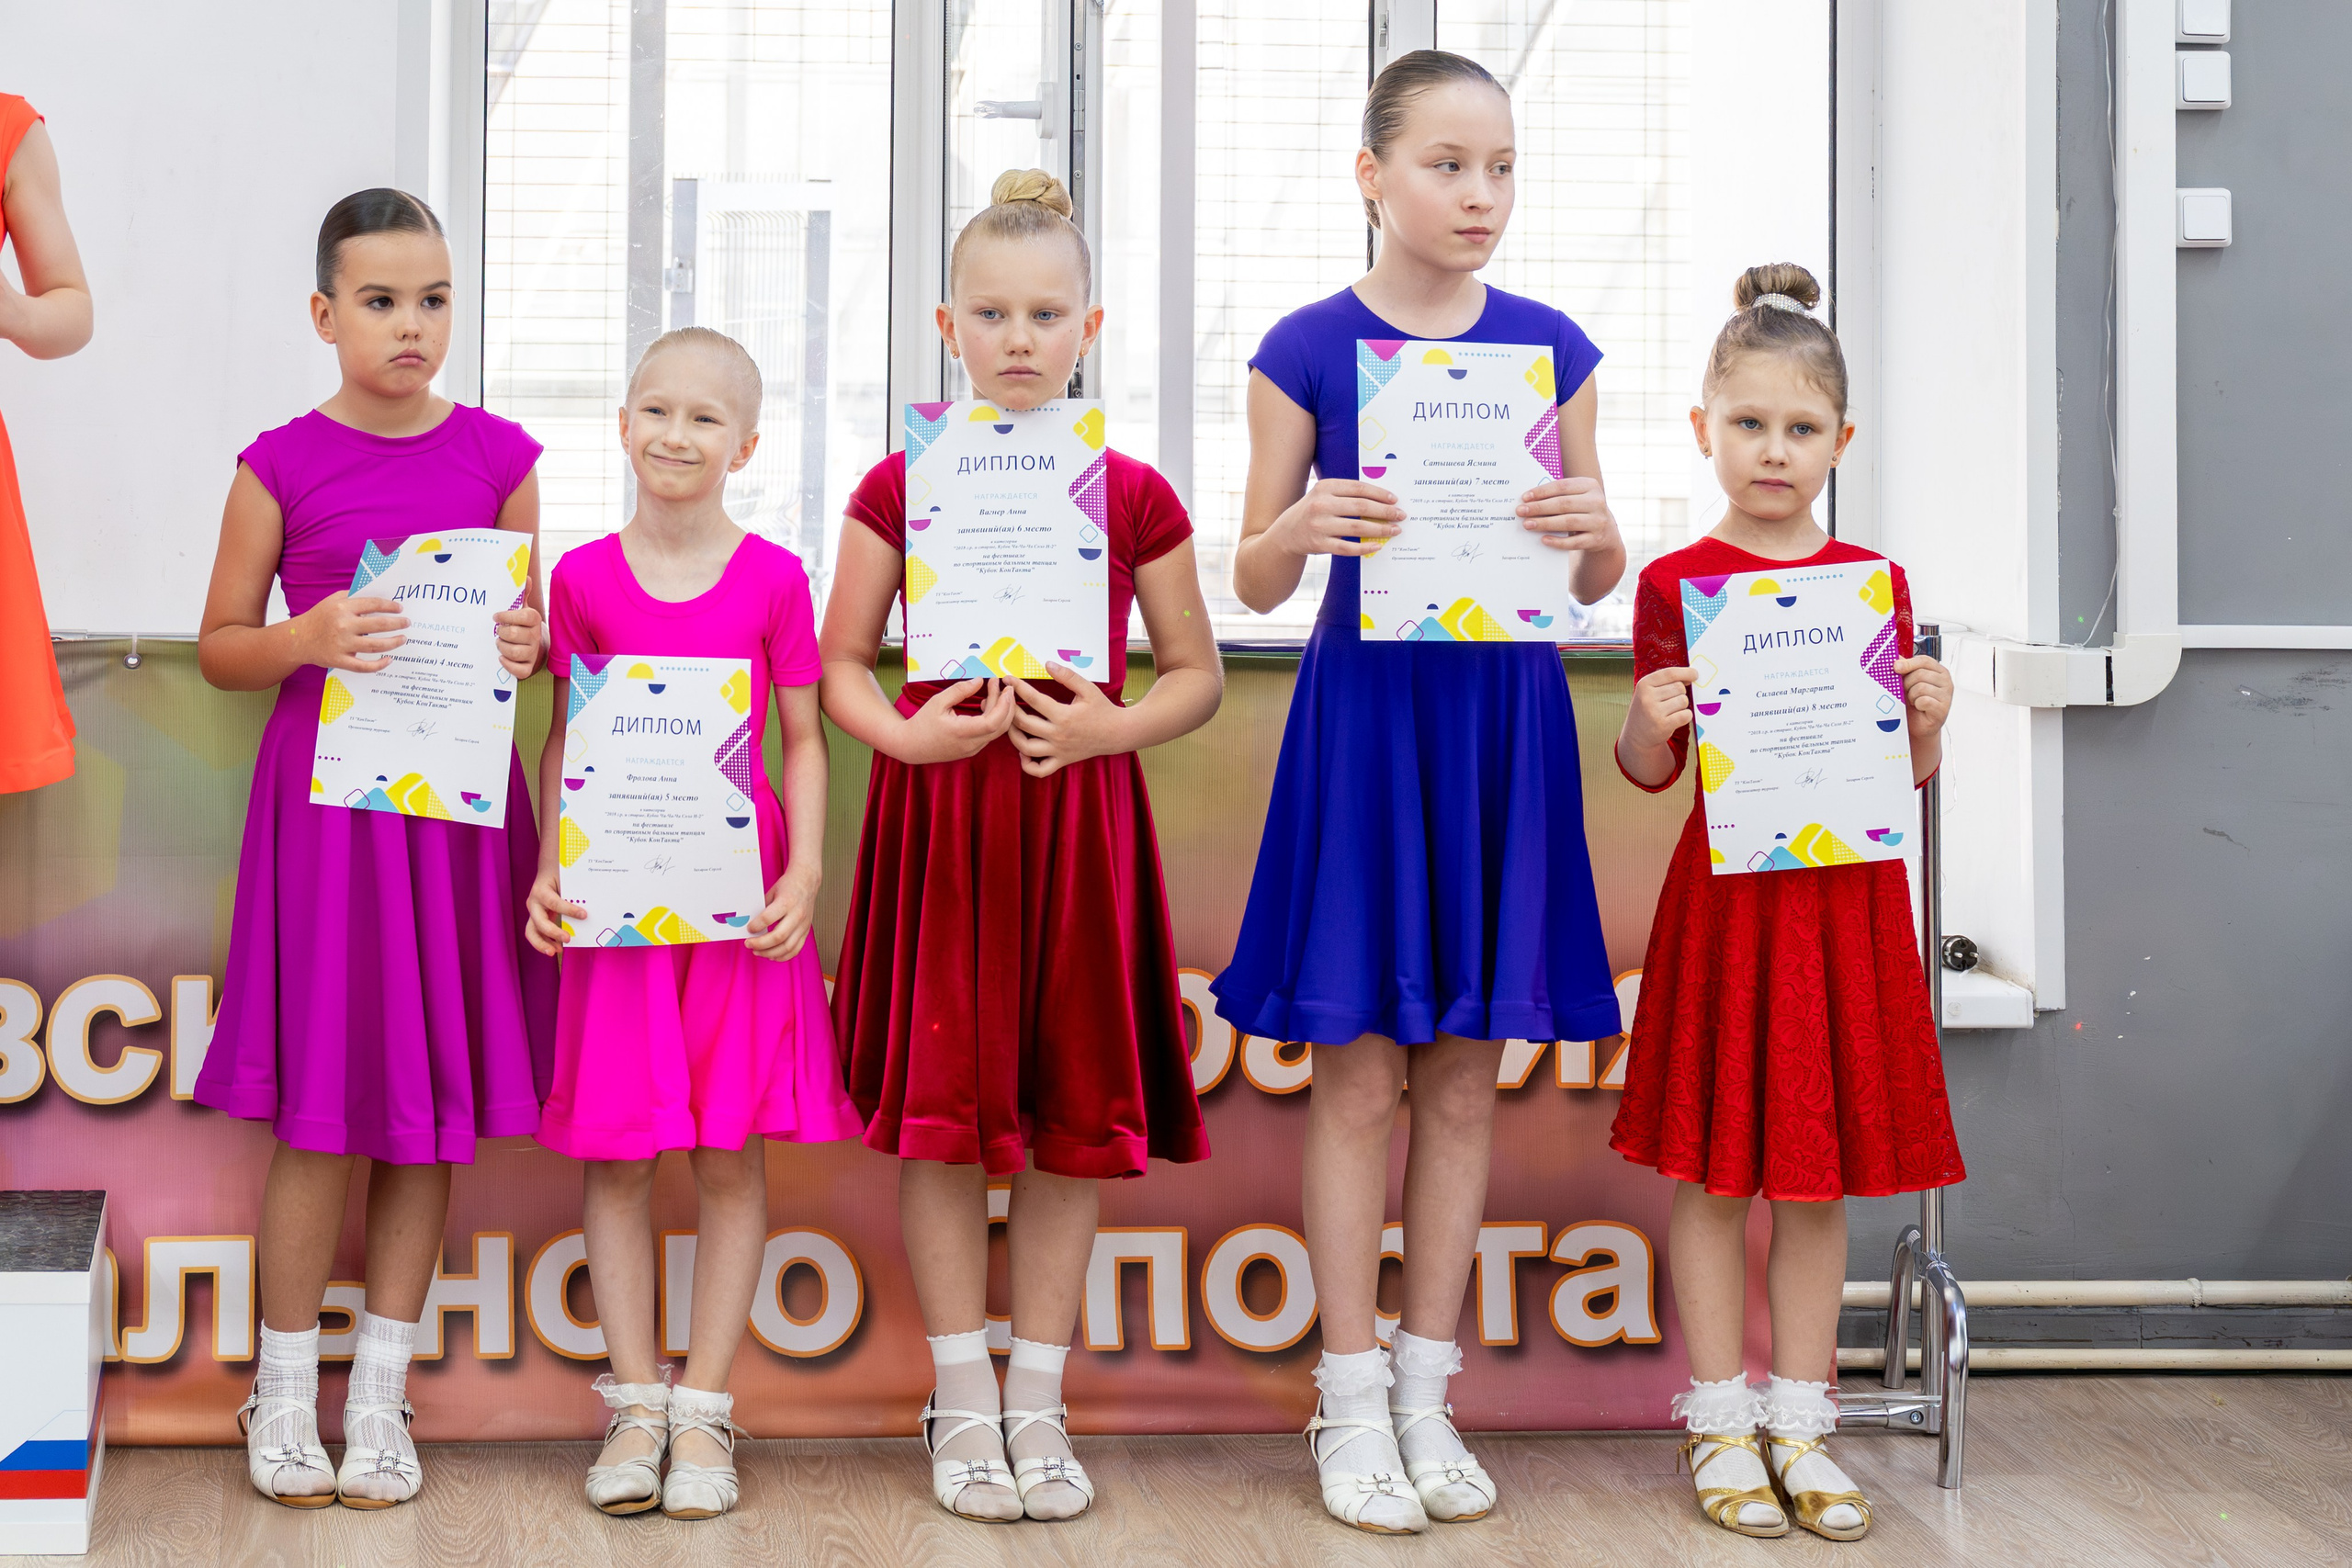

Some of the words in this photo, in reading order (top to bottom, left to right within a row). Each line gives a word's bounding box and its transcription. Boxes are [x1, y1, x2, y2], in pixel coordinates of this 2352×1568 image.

[1413, 401, 1510, 422] ДИПЛОМ
[957, 455, 1056, 476] ДИПЛОМ
[1414, 478, 1473, 486] занявший(ая)
[956, 525, 1015, 535] занявший(ая)
[1017, 525, 1023, 533] 6
[391, 583, 486, 606] ДИПЛОМ
[410, 622, 466, 634] ГРАЖДАЕТСЯ
[433, 639, 458, 649] Агата
[1743, 626, 1844, 655] ДИПЛОМ
[447, 660, 474, 670] место
[1764, 667, 1829, 681] НАГРАЖДАЕТСЯ
[1790, 684, 1835, 695] Маргарита
[1750, 705, 1810, 718] занявший(ая)
[1812, 703, 1817, 711] 8
[1818, 702, 1848, 711] место
[611, 716, 701, 736] ДИПЛОМ
[625, 757, 684, 766] НАГРАЖДАЕТСЯ
[608, 793, 663, 801] занявший(ая)
